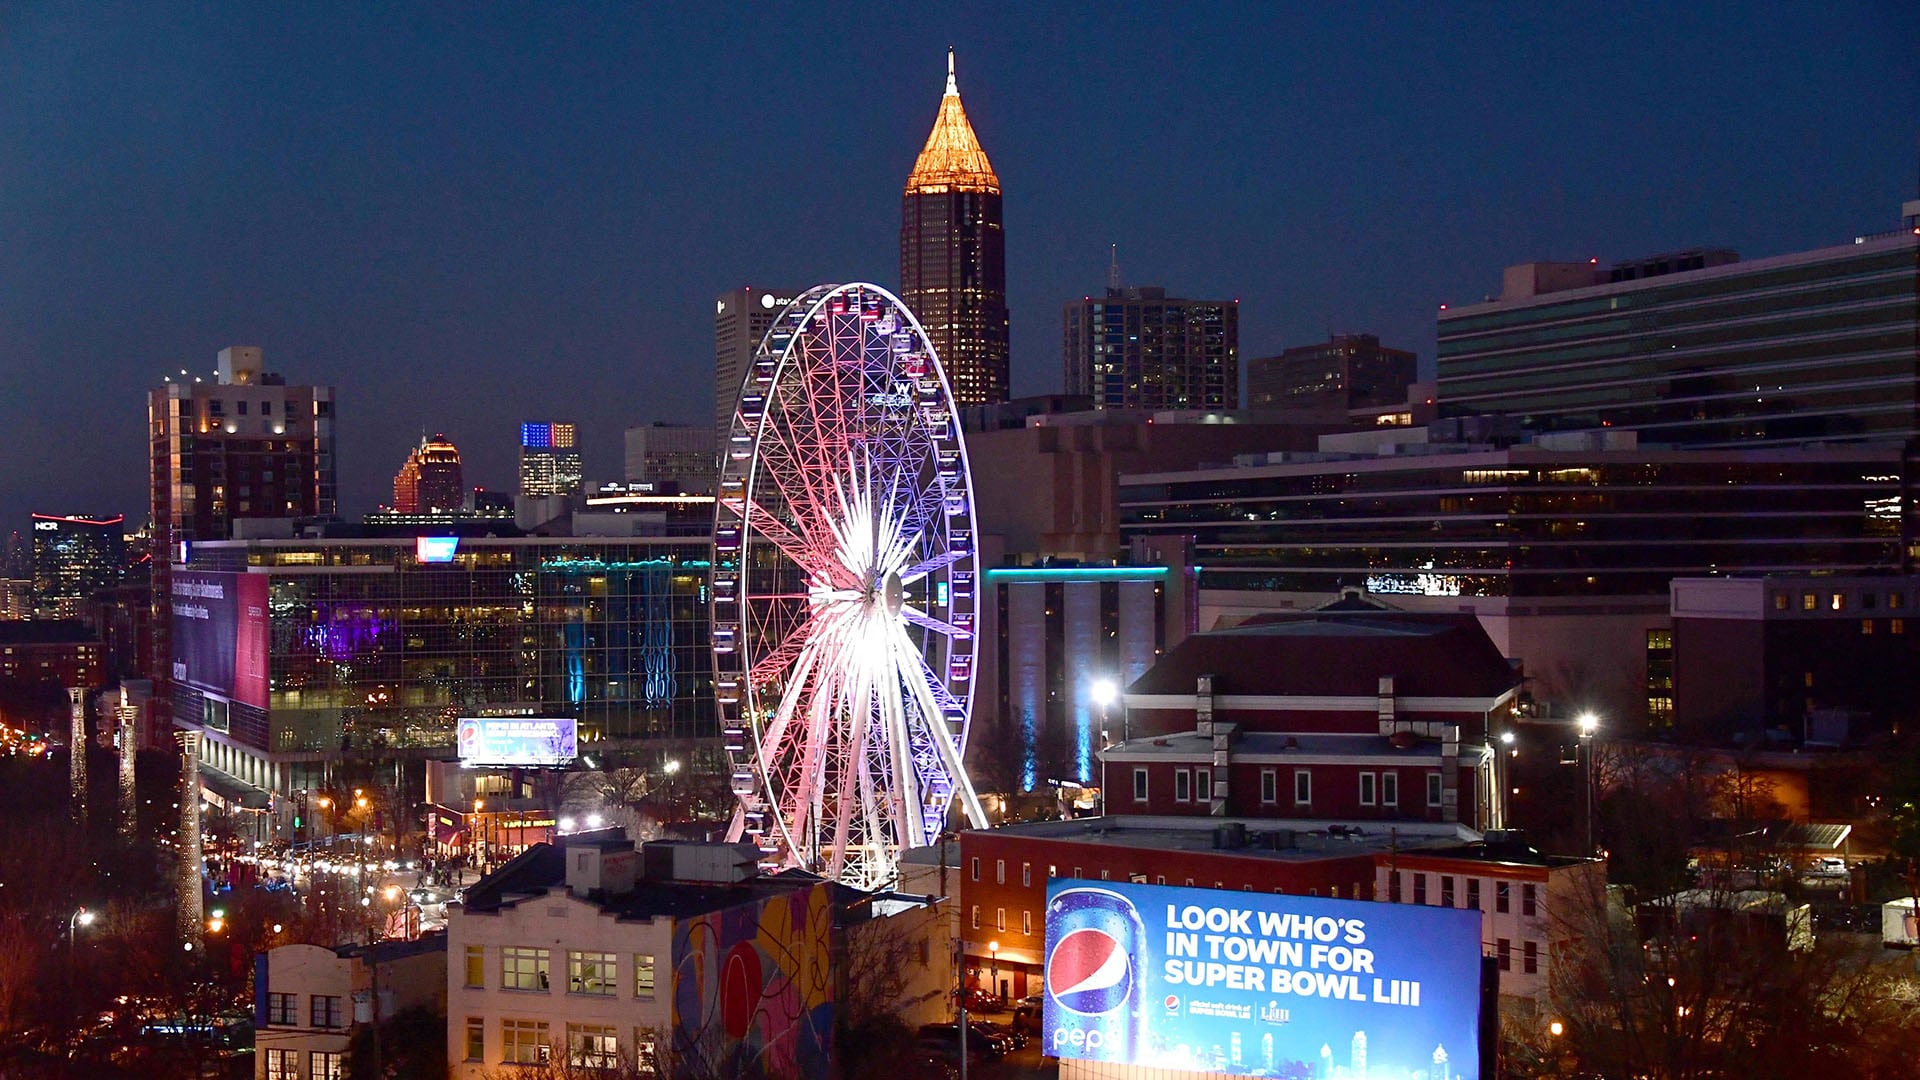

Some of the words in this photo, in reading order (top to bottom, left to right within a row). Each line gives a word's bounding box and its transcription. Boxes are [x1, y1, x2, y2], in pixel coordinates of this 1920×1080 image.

[894, 382, 911, 395] W
[34, 521, 58, 531] NCR
[1166, 904, 1253, 935] LOOK
[1257, 911, 1366, 945] WHO'S
[1166, 932, 1198, 958] IN
[1205, 934, 1303, 967] TOWN
[1310, 943, 1375, 974] FOR
[1164, 959, 1265, 992] SUPER
[1271, 968, 1367, 1001] BOWL
[1373, 977, 1420, 1007] LIII
[1053, 1027, 1120, 1053] pep
